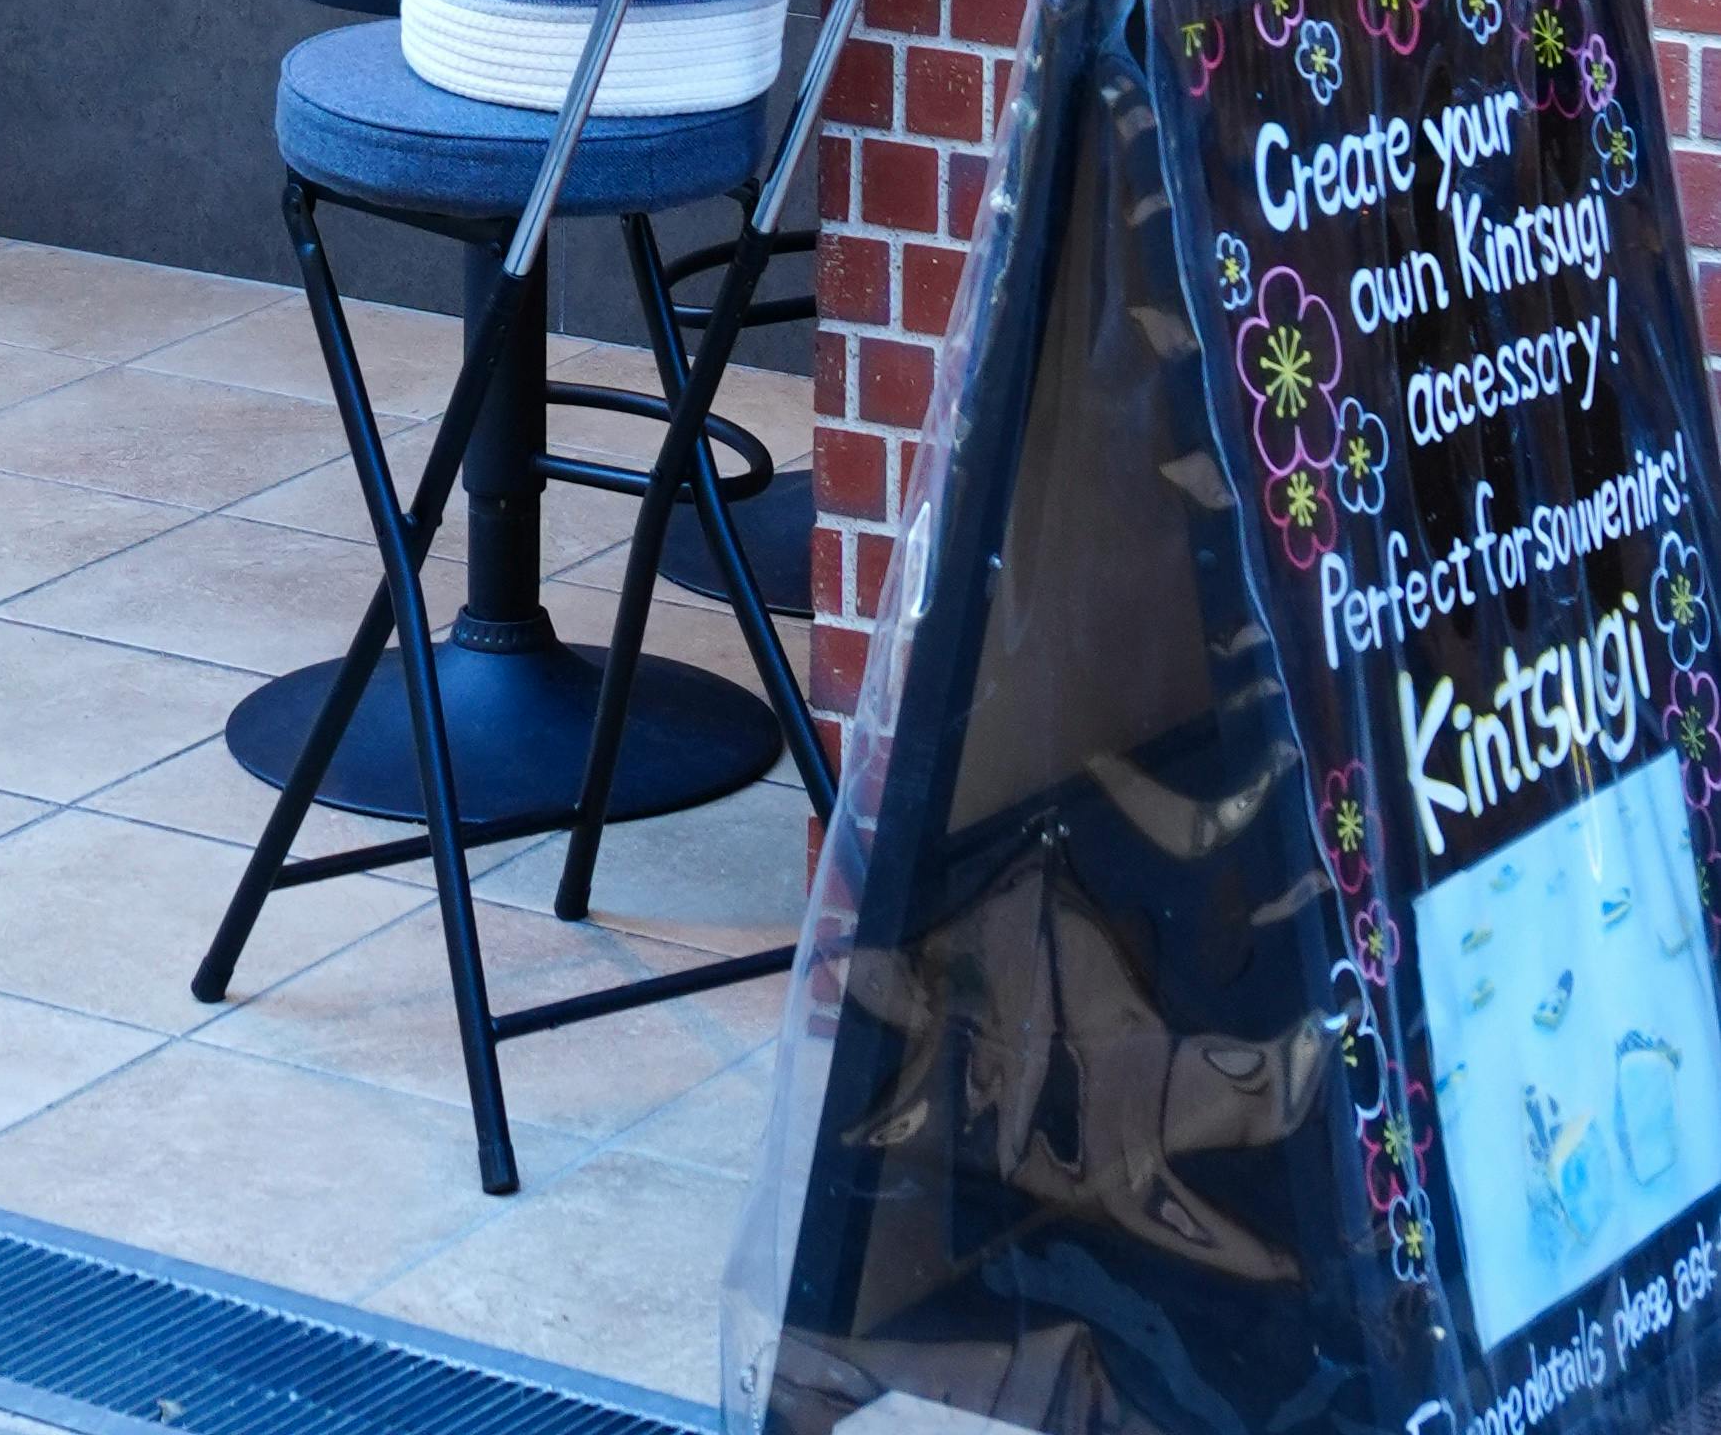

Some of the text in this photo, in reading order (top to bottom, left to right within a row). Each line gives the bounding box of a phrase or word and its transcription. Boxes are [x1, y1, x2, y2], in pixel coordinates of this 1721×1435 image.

[1254, 89, 1520, 231] Create your
[1349, 177, 1611, 333] own Kintsugi
[1406, 277, 1620, 446] accessory!
[1320, 430, 1690, 671] Perfect for souvenirs!
[1396, 590, 1652, 857] Kintsugi
[1524, 1304, 1607, 1426] details
[1673, 1221, 1718, 1313] ask
